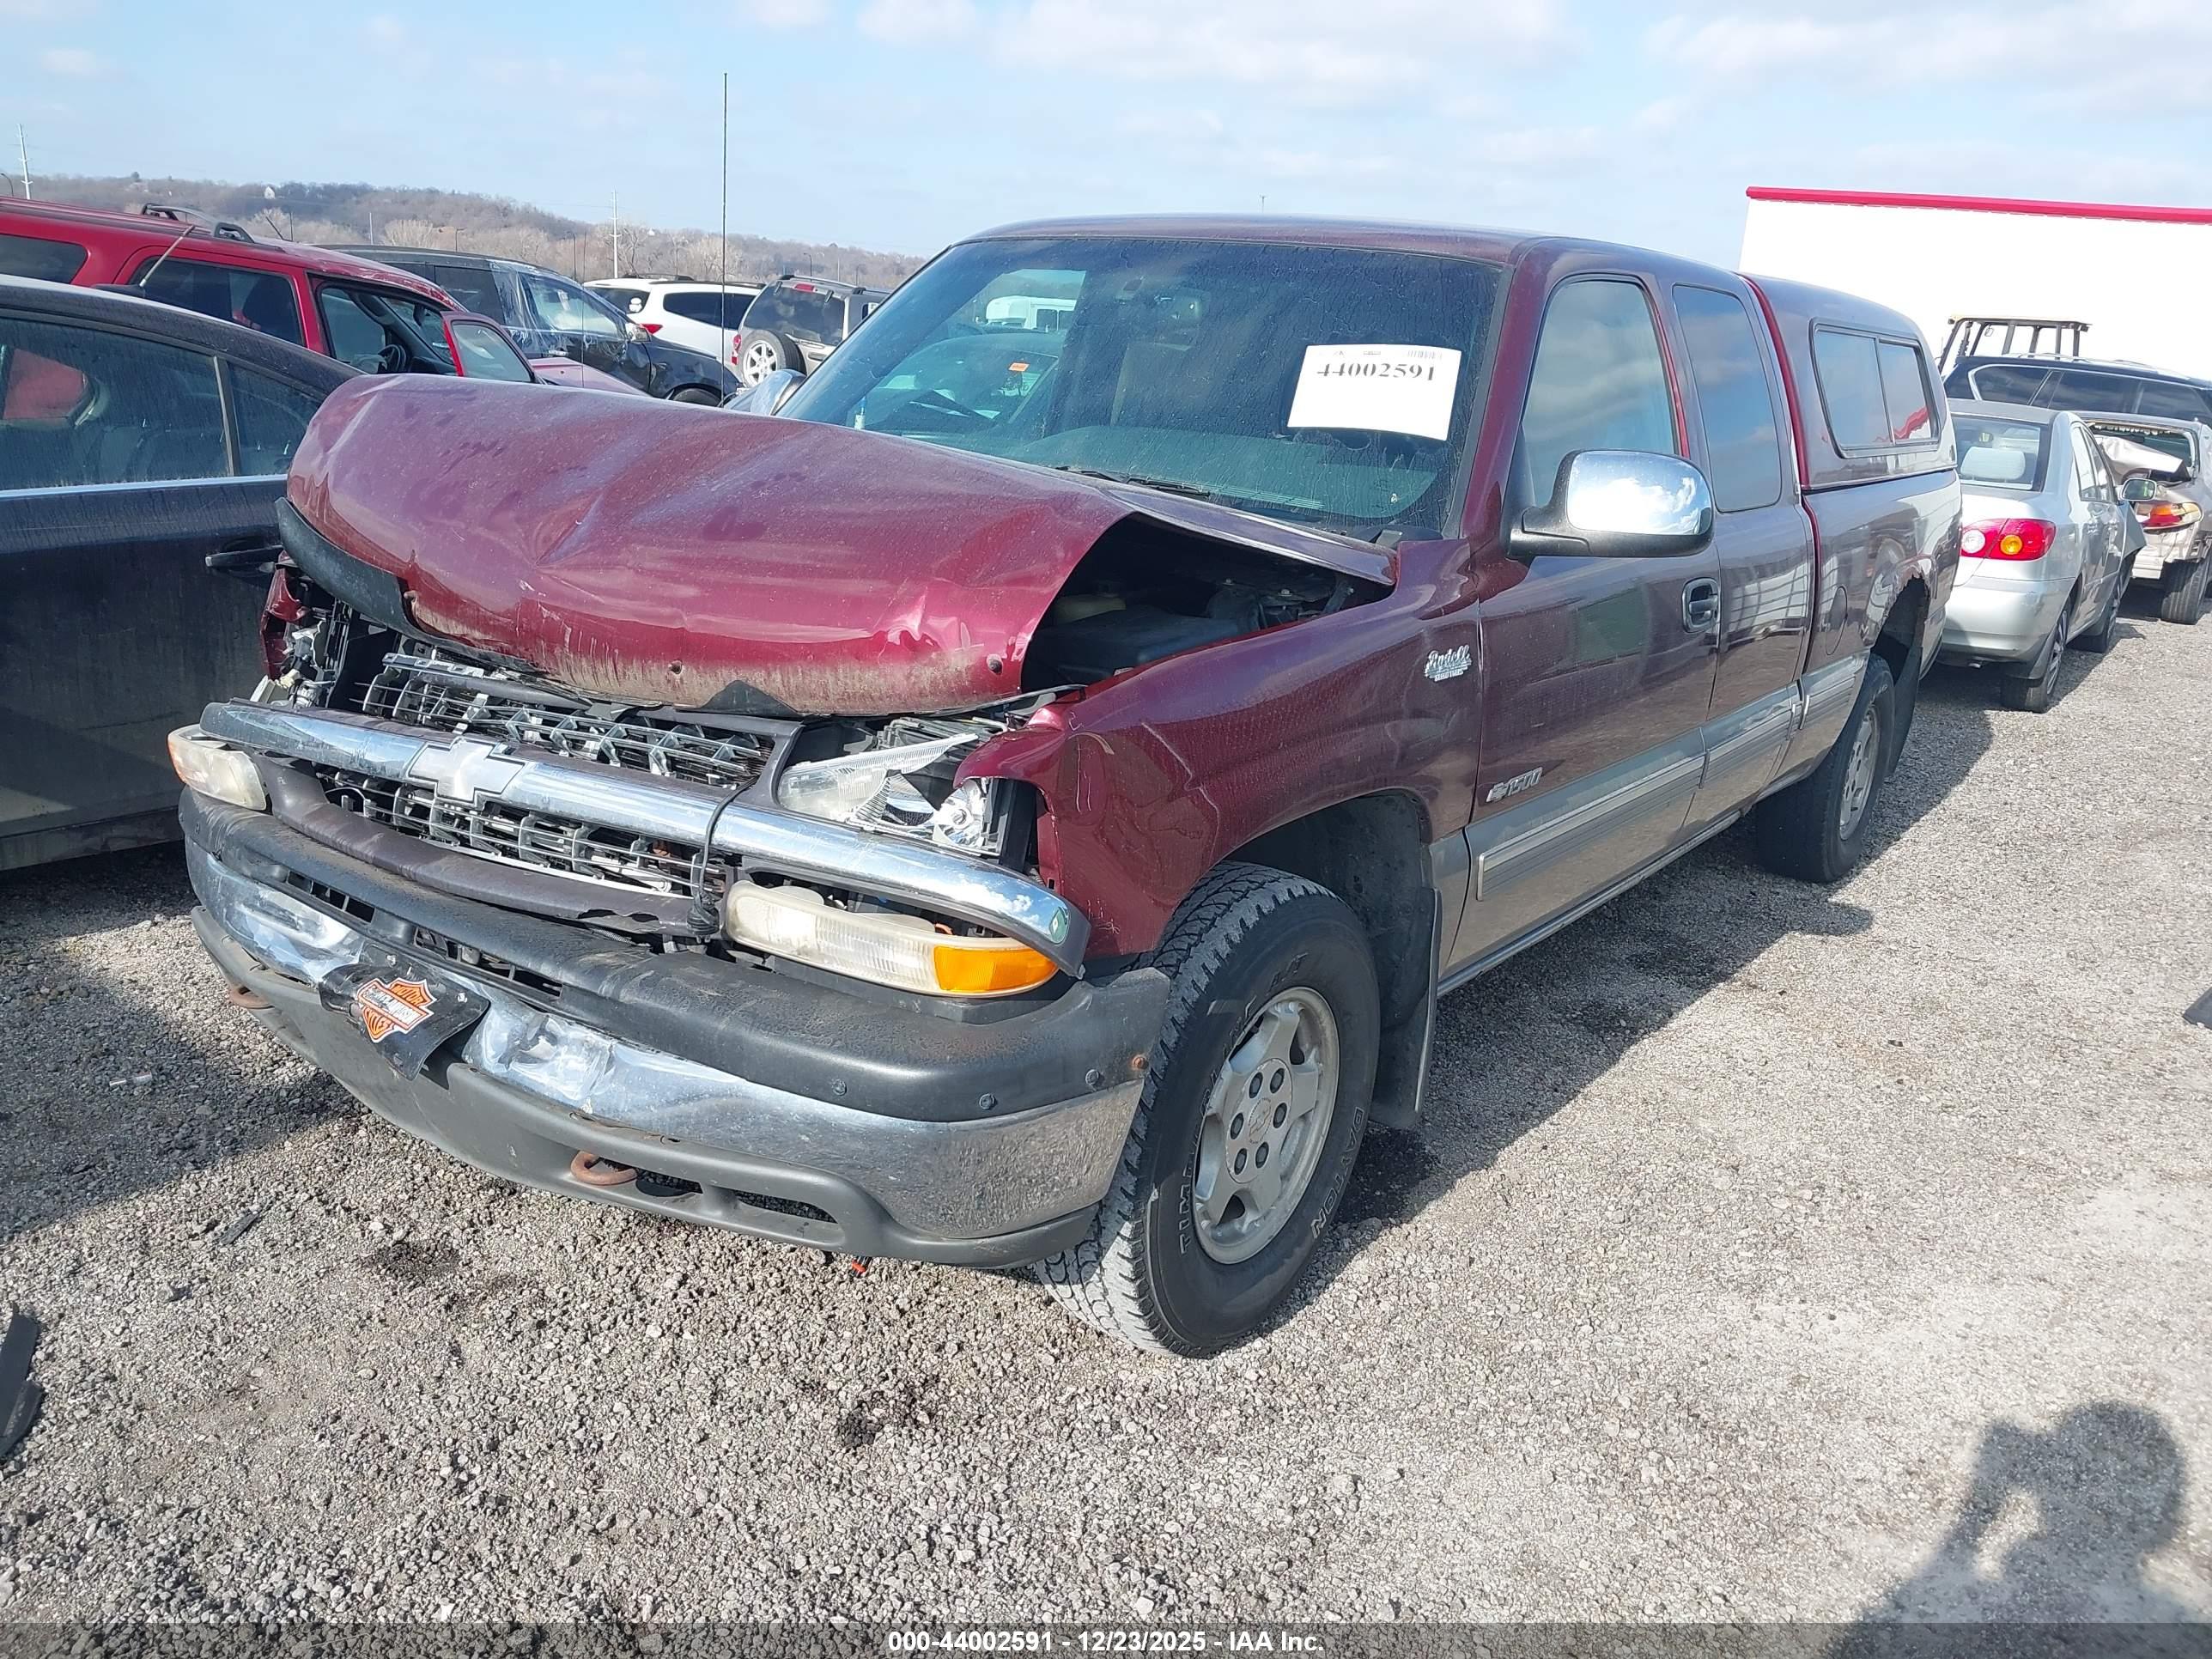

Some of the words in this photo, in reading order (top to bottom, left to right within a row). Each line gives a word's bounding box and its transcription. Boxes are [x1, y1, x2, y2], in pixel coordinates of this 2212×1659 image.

[1316, 362, 1435, 381] 44002591
[391, 984, 426, 1006] MOTOR
[1311, 1106, 1364, 1239] DAYTON
